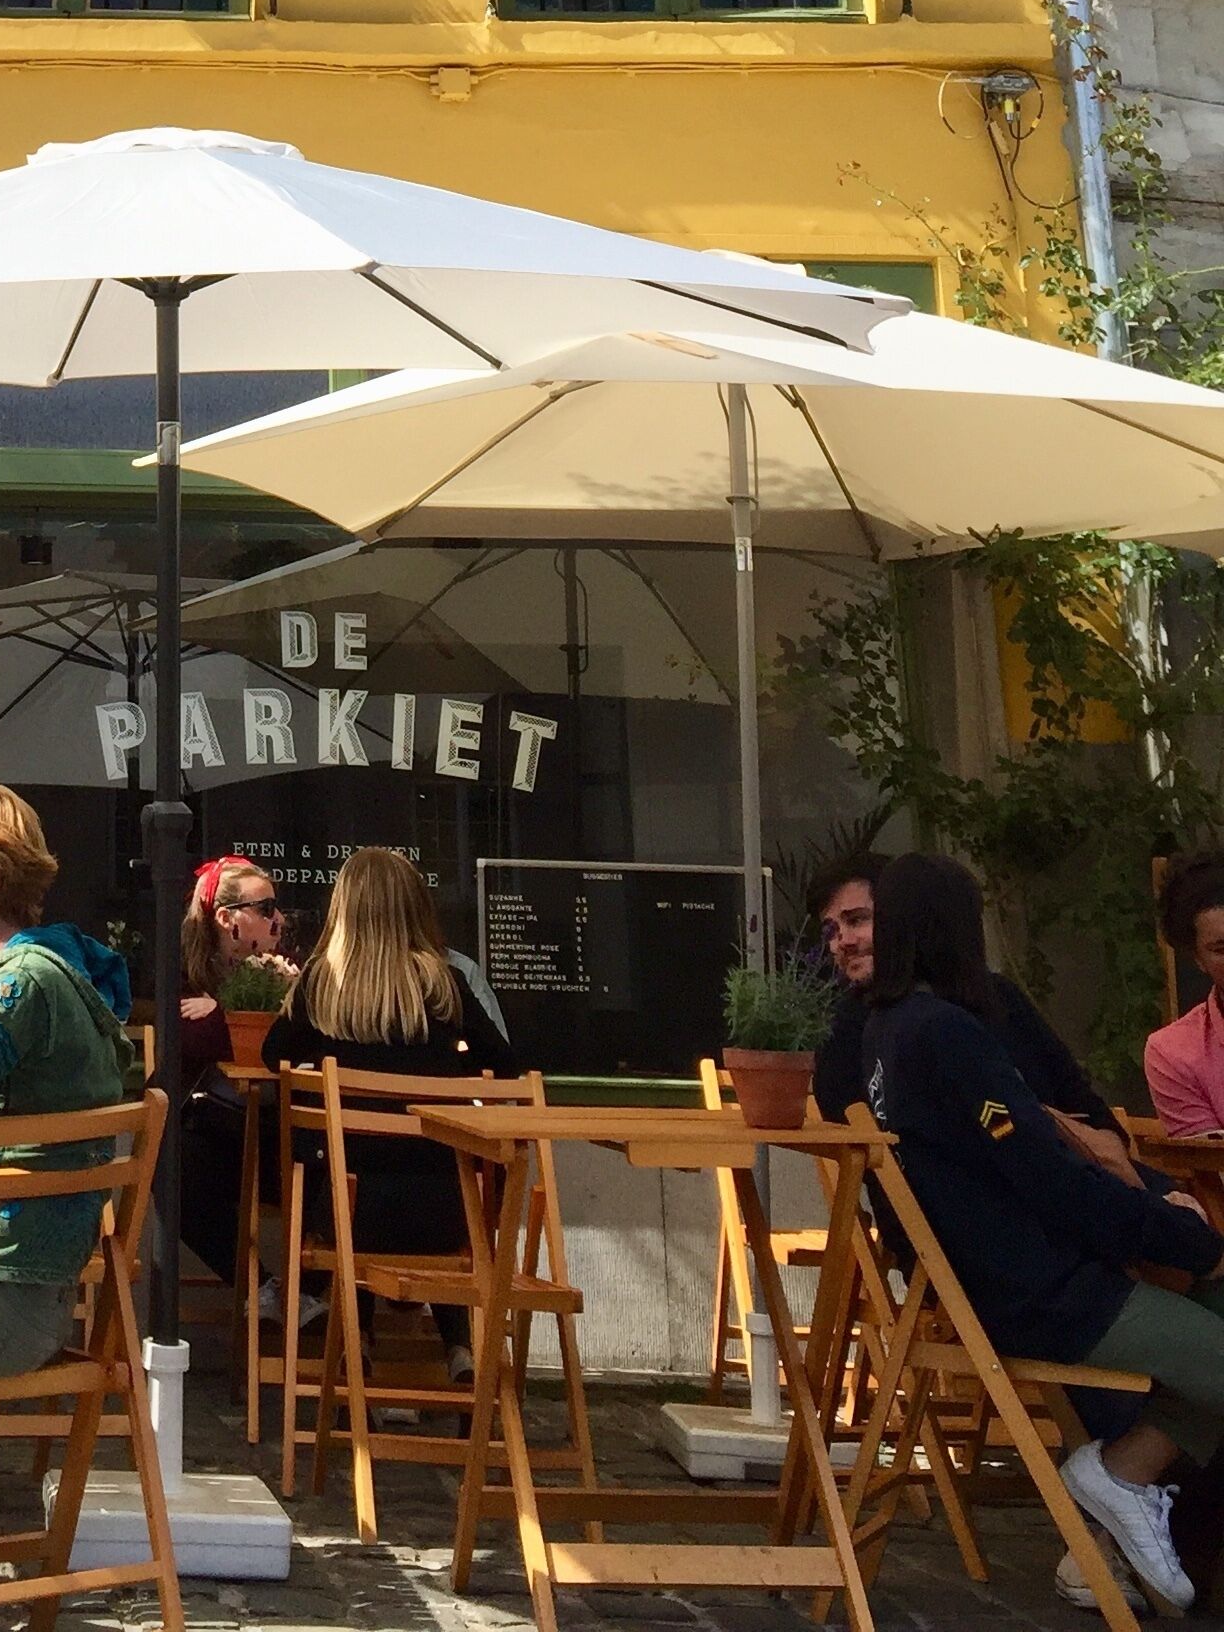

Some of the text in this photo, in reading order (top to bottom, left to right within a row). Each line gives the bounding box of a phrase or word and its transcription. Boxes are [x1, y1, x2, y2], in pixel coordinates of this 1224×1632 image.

[280, 611, 368, 671] DE
[95, 687, 559, 793] PARKIET
[232, 841, 286, 859] ETEN
[301, 844, 311, 859] &
